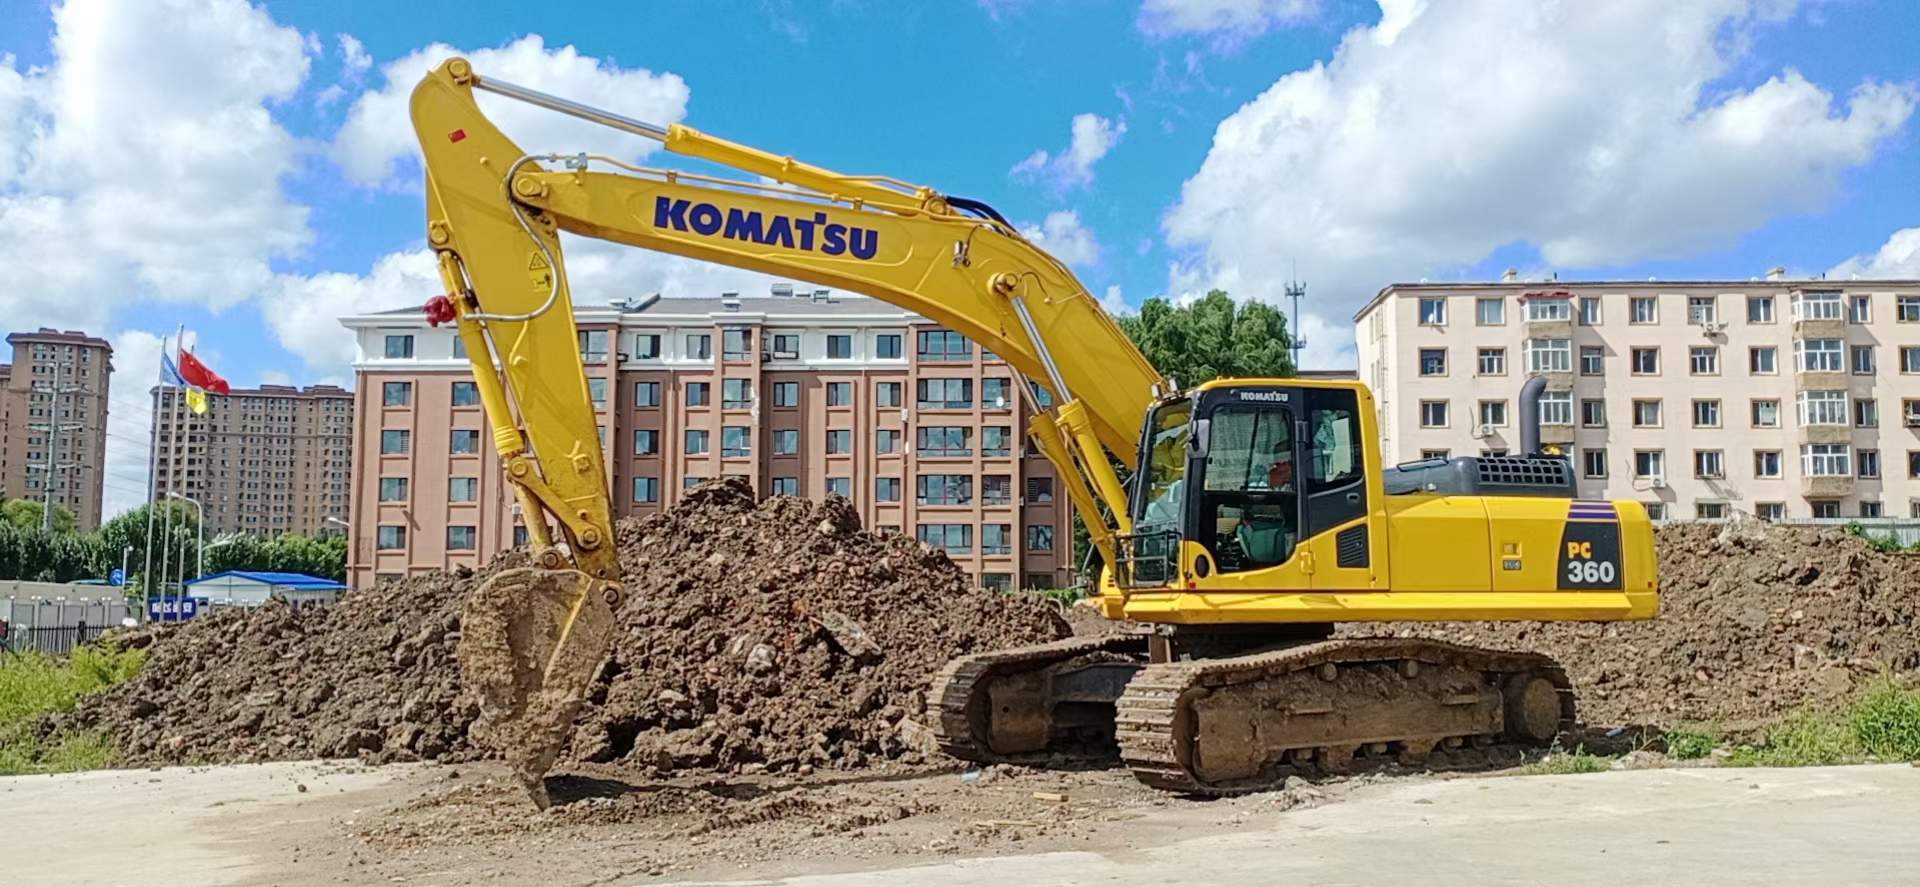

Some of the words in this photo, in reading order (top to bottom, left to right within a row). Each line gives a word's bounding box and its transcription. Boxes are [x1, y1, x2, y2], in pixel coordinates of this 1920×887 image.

[653, 196, 879, 260] KOMATSU
[1240, 391, 1289, 402] KOMATSU
[1567, 541, 1592, 559] PC
[1567, 560, 1615, 583] 360
